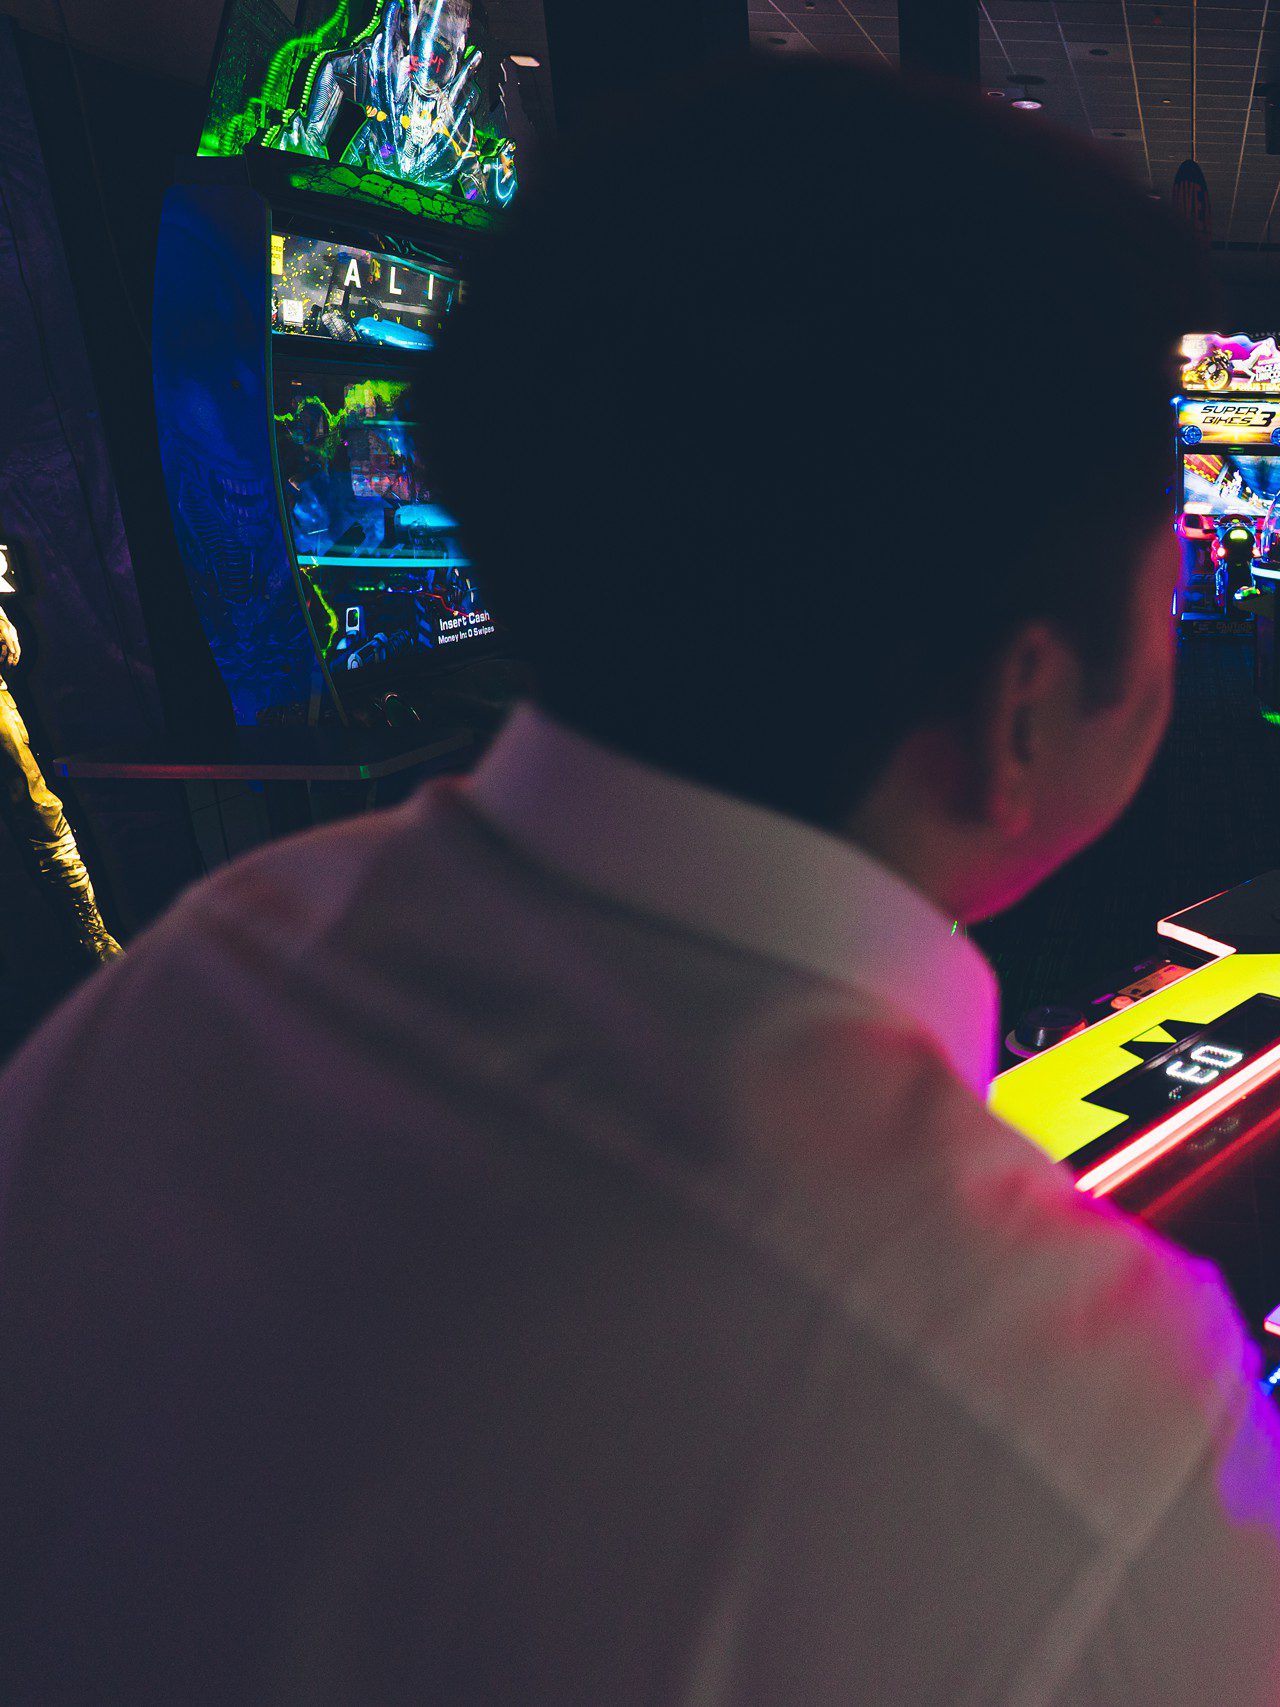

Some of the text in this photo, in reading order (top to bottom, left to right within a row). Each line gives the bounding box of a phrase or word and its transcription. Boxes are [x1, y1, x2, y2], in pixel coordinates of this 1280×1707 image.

[1201, 405, 1259, 415] SUPER
[1203, 411, 1276, 427] BIKES 3
[439, 610, 490, 631] Insert Cash
[438, 634, 459, 645] Money
[473, 625, 495, 636] Swipes
